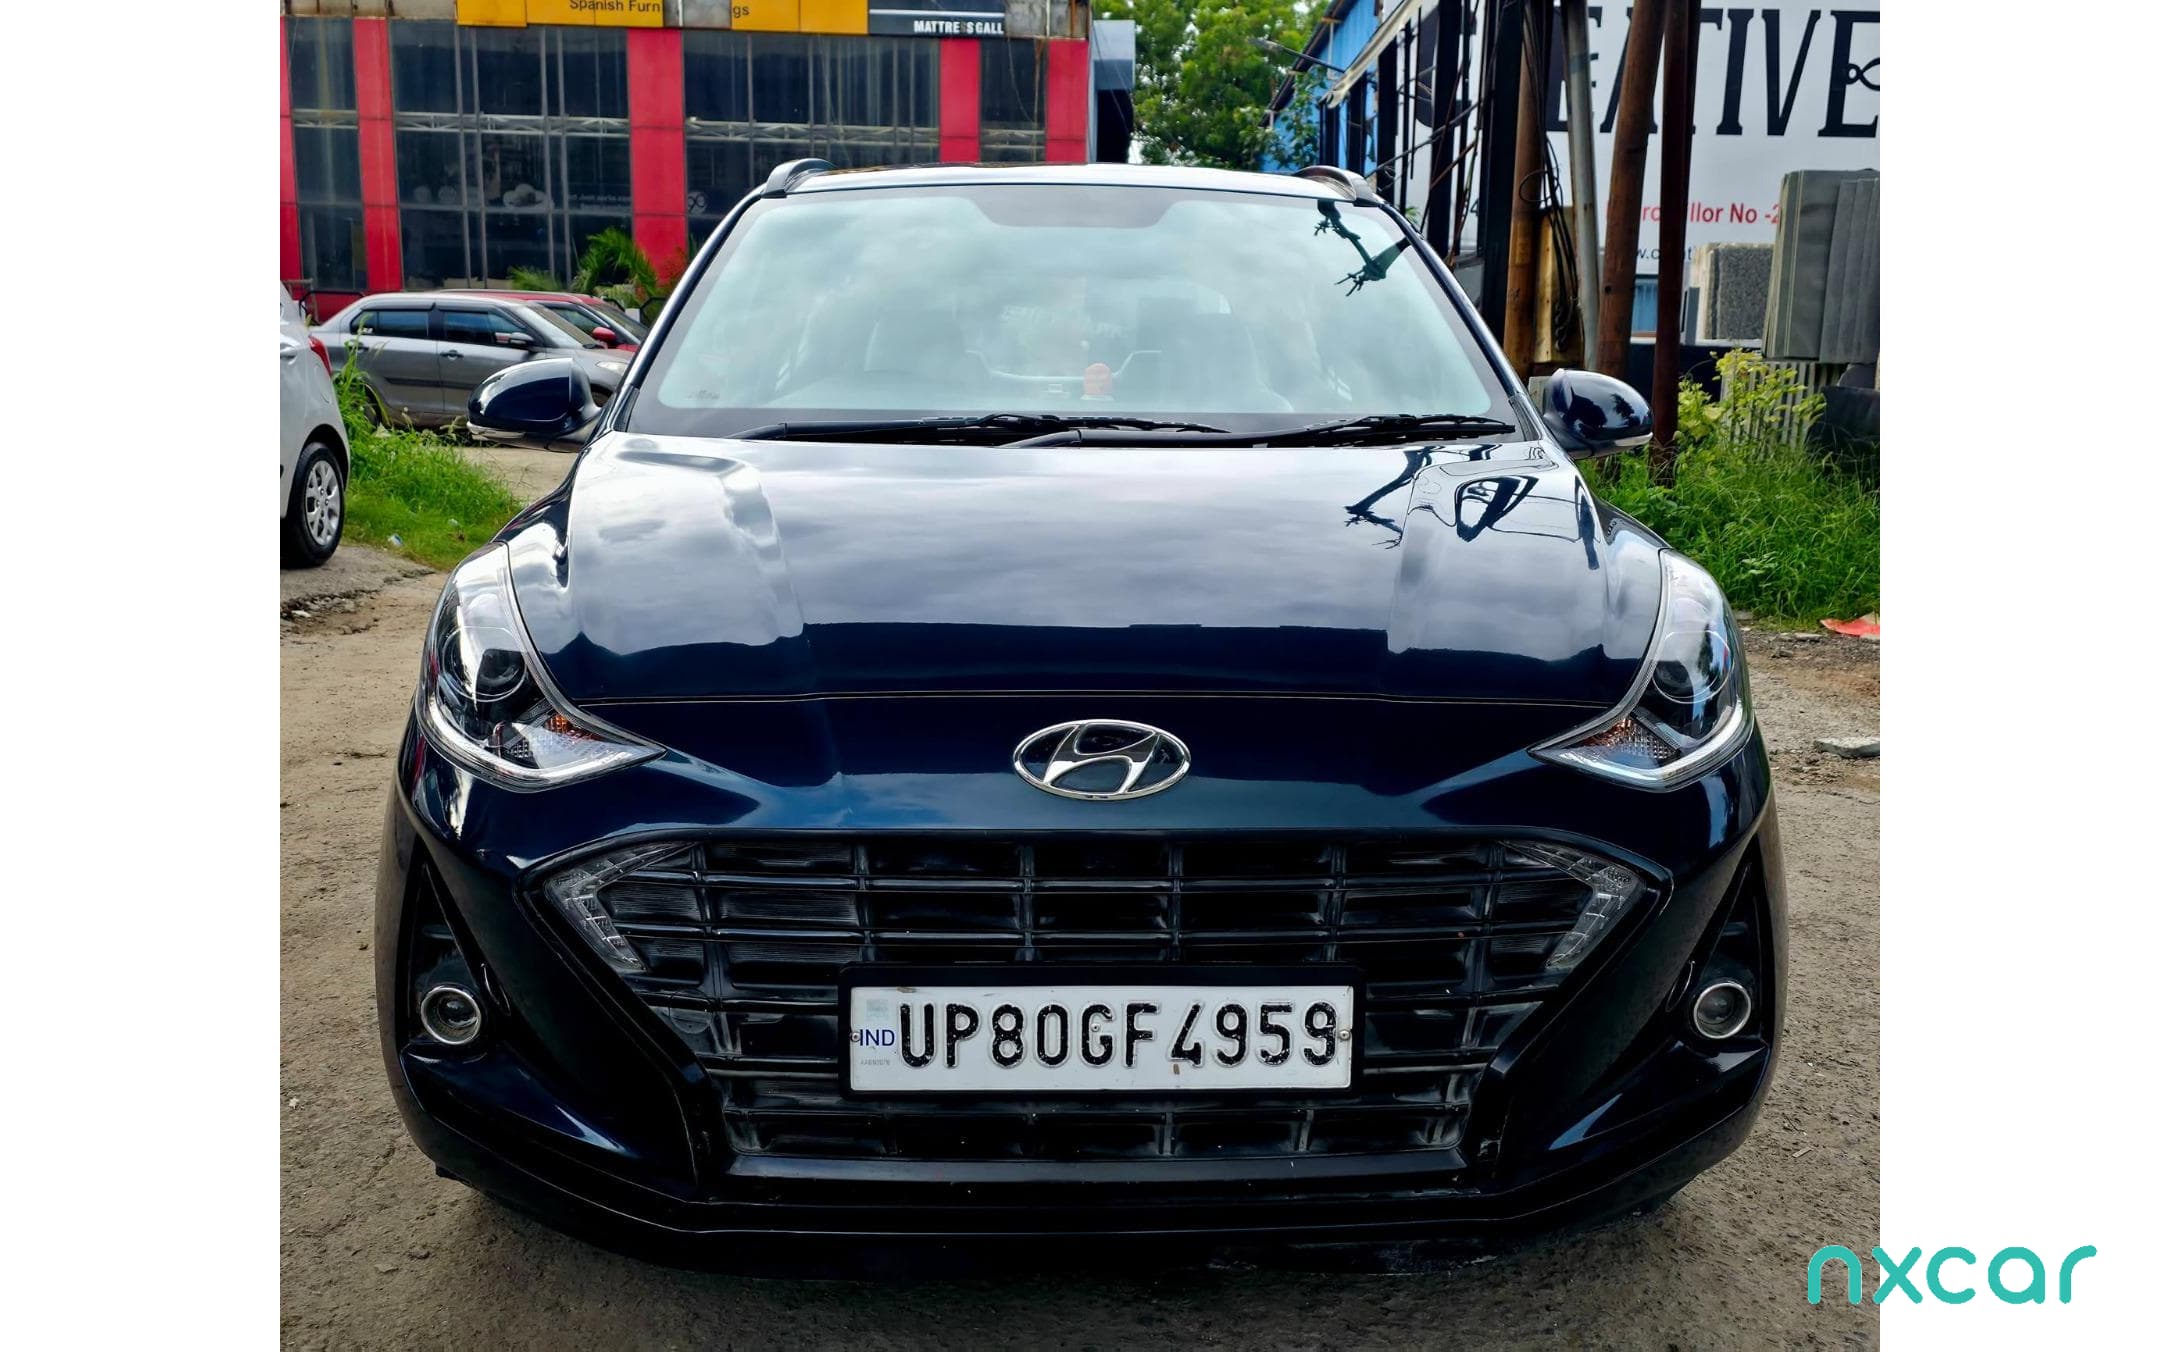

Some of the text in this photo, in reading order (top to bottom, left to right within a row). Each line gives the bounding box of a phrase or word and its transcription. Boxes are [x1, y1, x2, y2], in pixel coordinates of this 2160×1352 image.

[569, 0, 660, 12] Spanish Furn
[1730, 203, 1757, 223] No
[860, 1002, 1337, 1070] IND UP80GF4959
